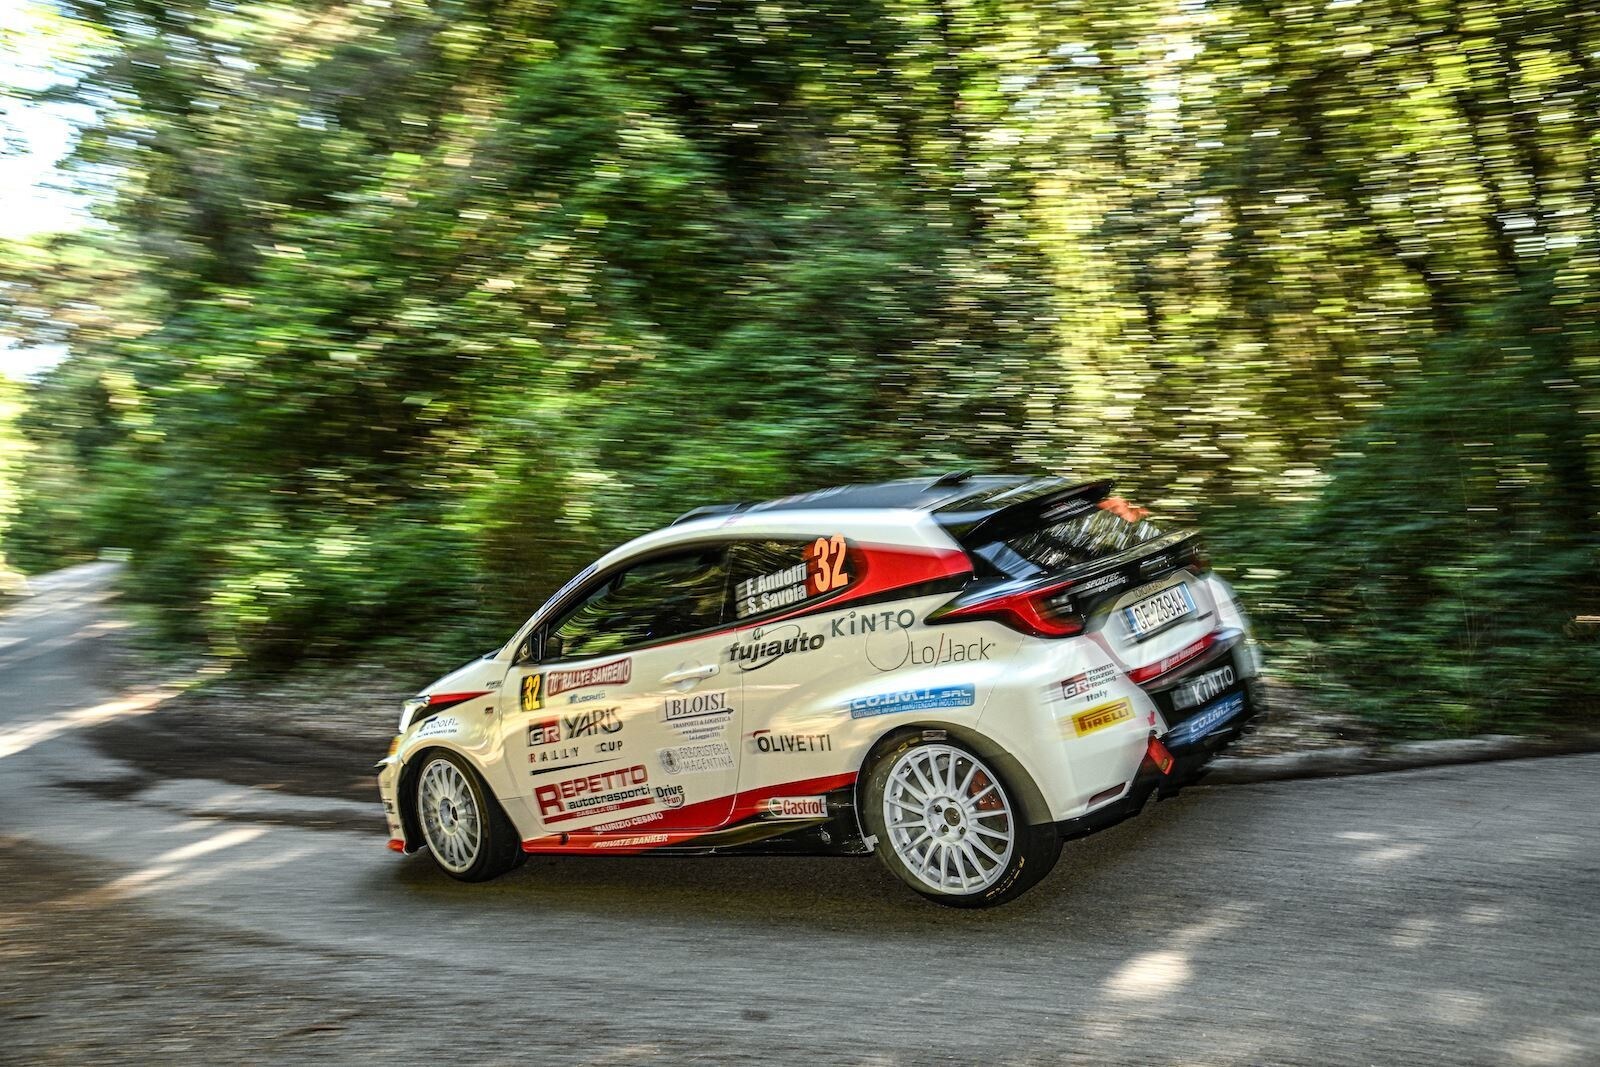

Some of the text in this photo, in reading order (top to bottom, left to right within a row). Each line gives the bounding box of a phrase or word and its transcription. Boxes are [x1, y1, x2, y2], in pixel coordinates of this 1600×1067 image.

[813, 532, 848, 592] 32
[747, 584, 807, 614] S. Savoia
[561, 669, 592, 688] RALLYE
[591, 660, 630, 683] SANREMO
[524, 674, 541, 710] 32
[1086, 690, 1108, 702] Italy
[672, 692, 726, 716] BLOISI
[1078, 702, 1129, 732] PIRELLI
[530, 724, 560, 746] GR
[757, 734, 832, 753] OLIVETTI
[528, 740, 624, 763] RALLY CUP
[534, 764, 648, 816] REPETTO
[568, 784, 651, 810] autotrasporti
[655, 784, 684, 798] Drive
[783, 798, 824, 816] Castrol
[594, 812, 663, 834] MAURIZIO CESANO
[595, 834, 669, 849] PRIVATE BANKER
